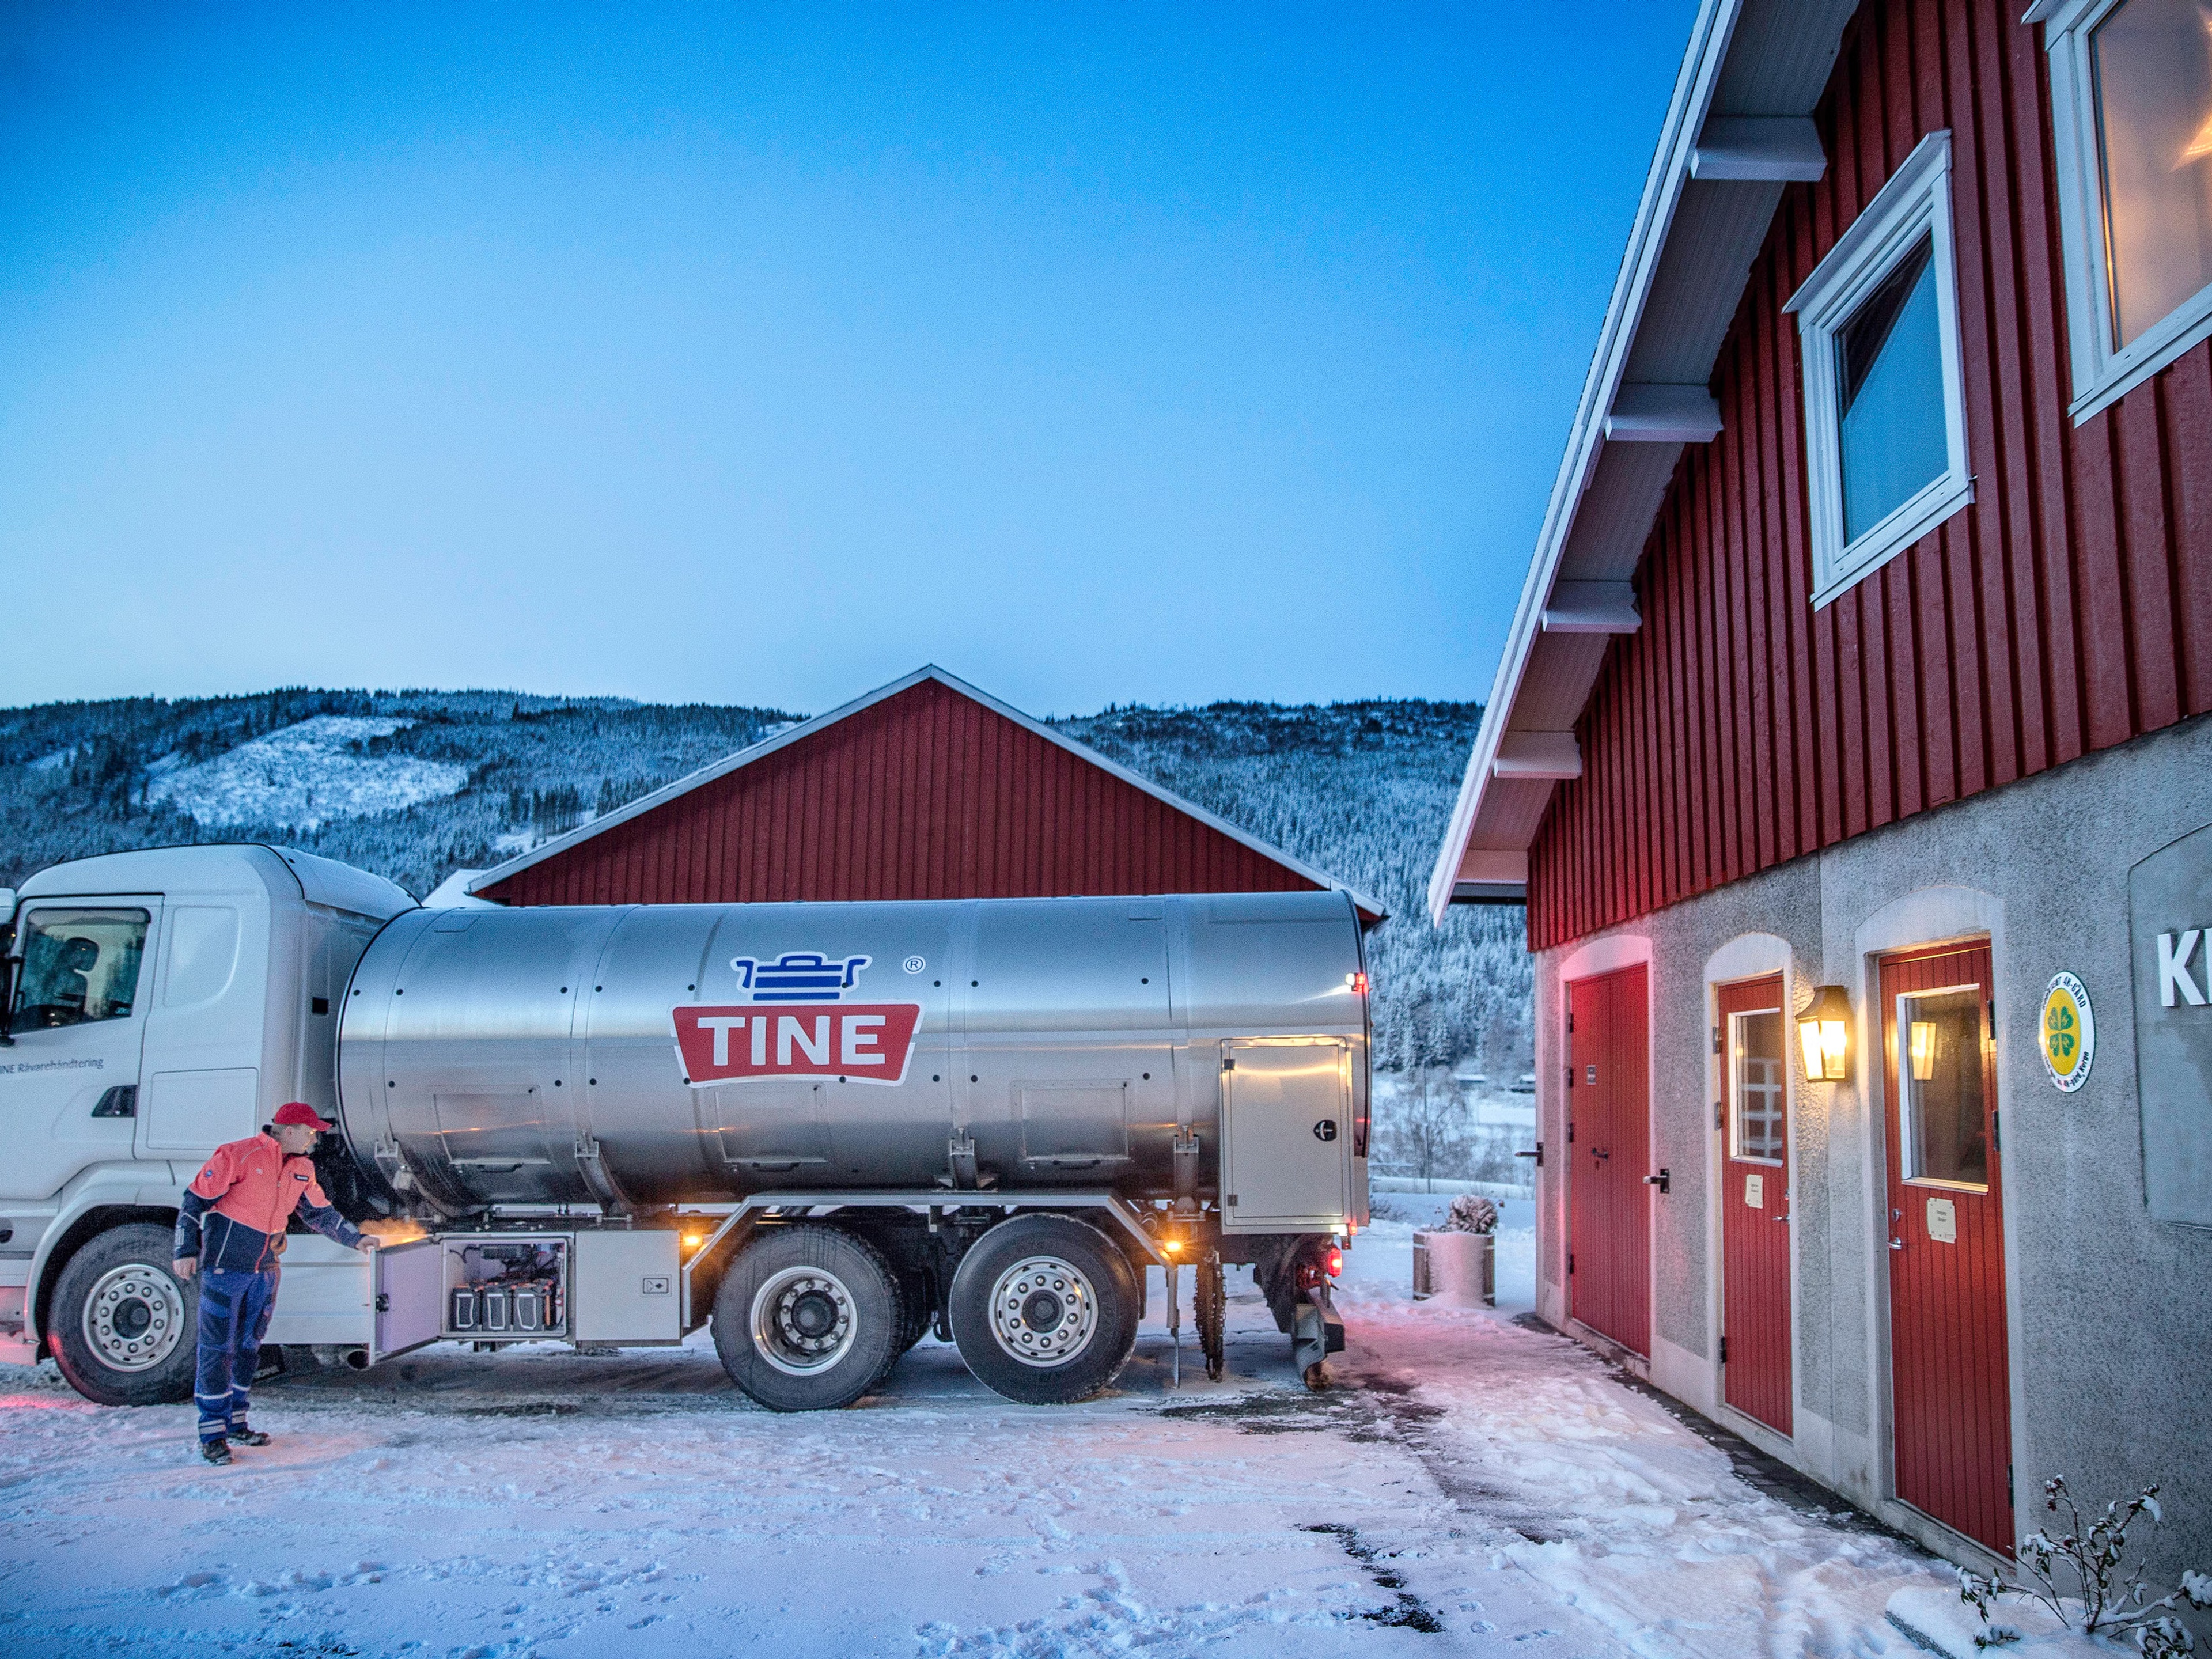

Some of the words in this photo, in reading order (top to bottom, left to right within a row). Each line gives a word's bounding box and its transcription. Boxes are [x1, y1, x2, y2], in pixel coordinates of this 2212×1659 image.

[697, 1015, 887, 1066] TINE
[0, 1065, 15, 1074] INE
[17, 1058, 104, 1073] Råvarehåndtering
